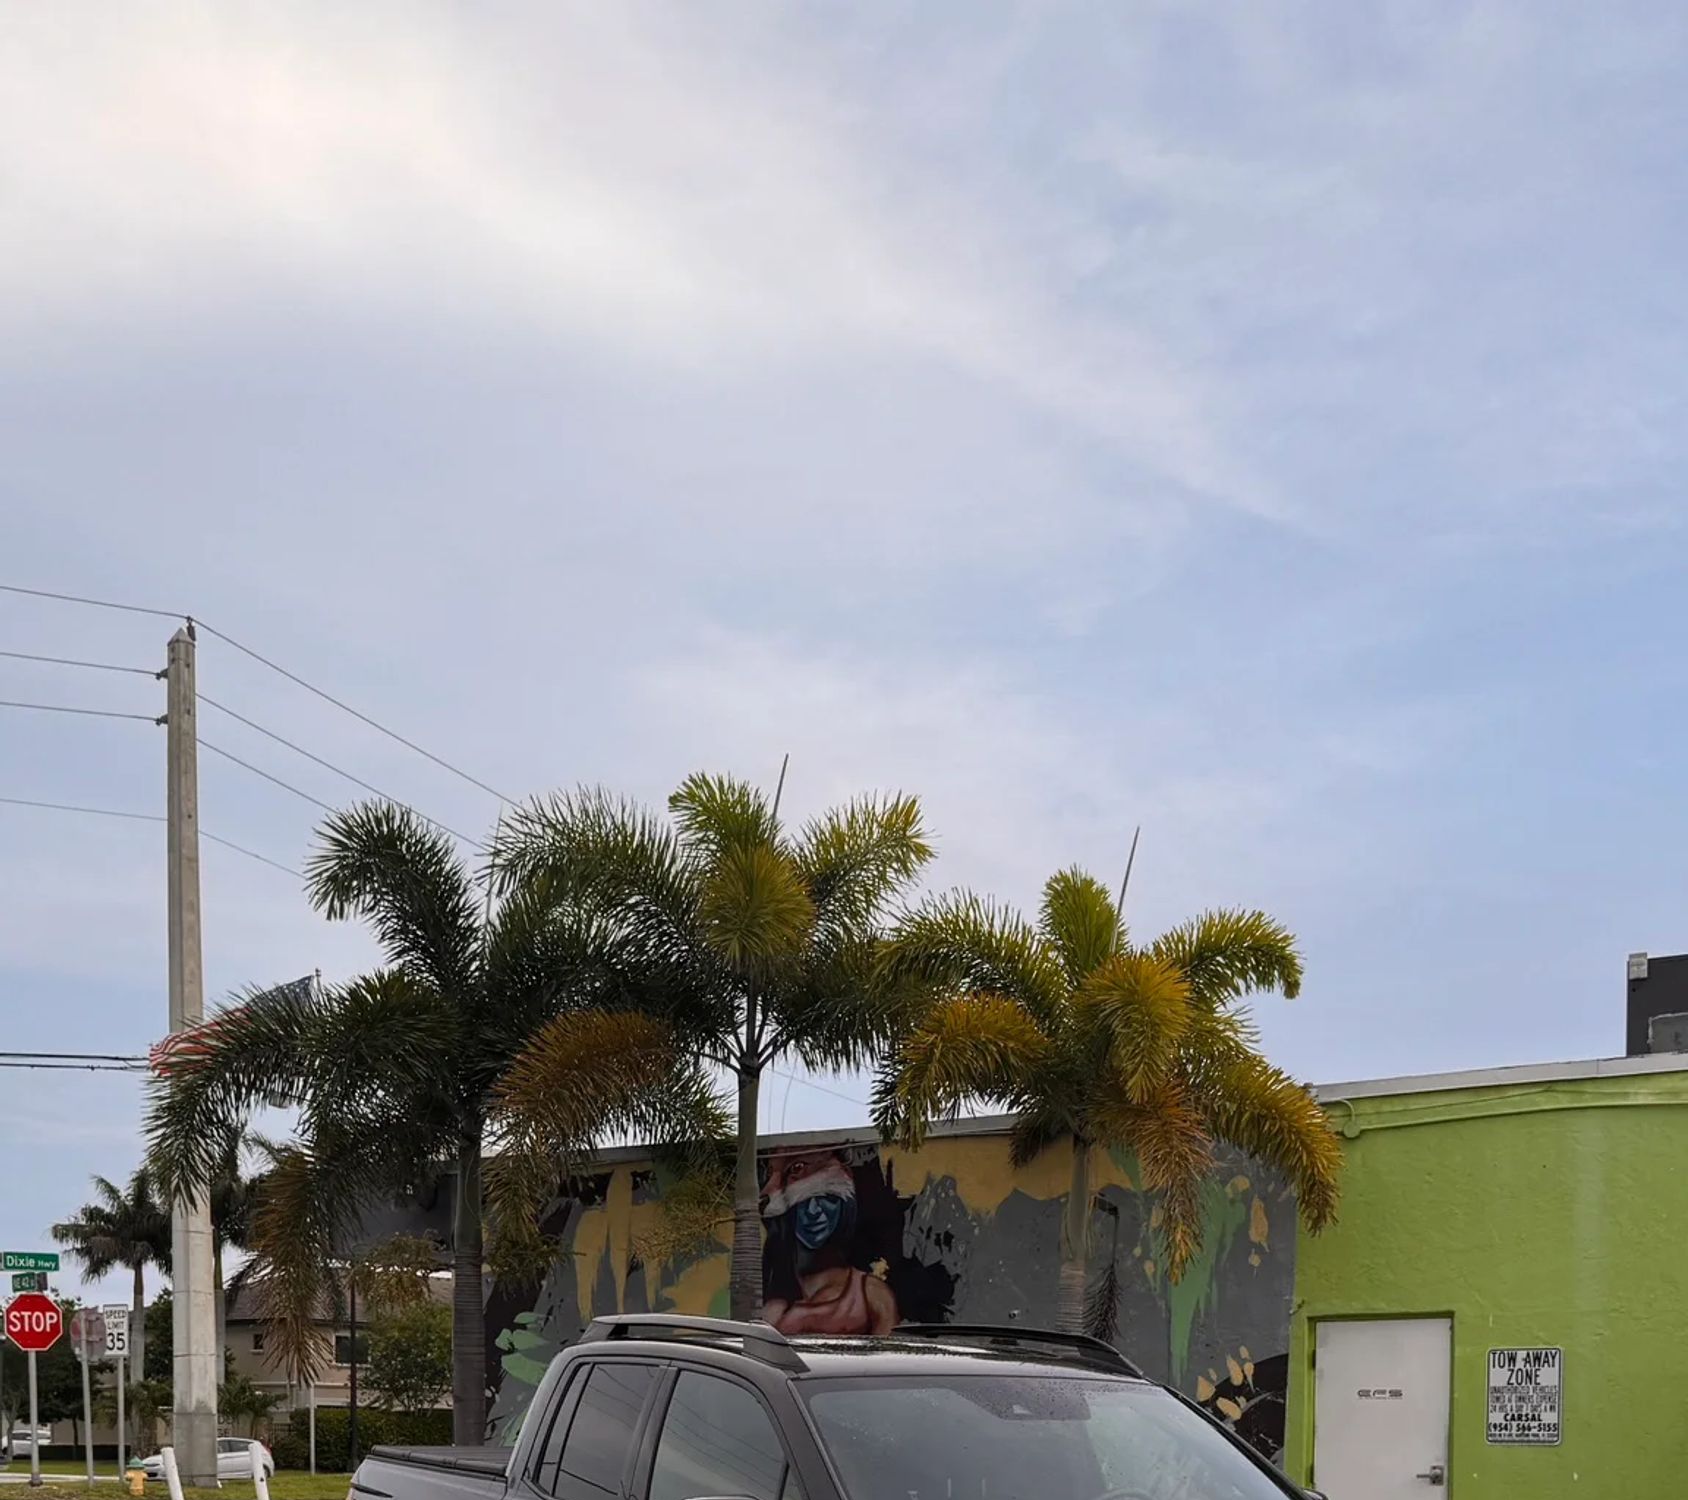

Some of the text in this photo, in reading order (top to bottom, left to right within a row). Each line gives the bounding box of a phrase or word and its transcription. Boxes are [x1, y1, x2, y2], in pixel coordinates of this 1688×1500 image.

[6, 1255, 56, 1270] Dixie Hwy
[9, 1311, 58, 1332] STOP
[105, 1309, 126, 1319] SPEED
[107, 1321, 124, 1330] LIMIT
[106, 1332, 125, 1351] 35
[1492, 1350, 1557, 1369] TOW AWAY
[1507, 1368, 1541, 1385] ZONE
[1503, 1413, 1543, 1422] CARSAL
[1488, 1422, 1513, 1432] (954)
